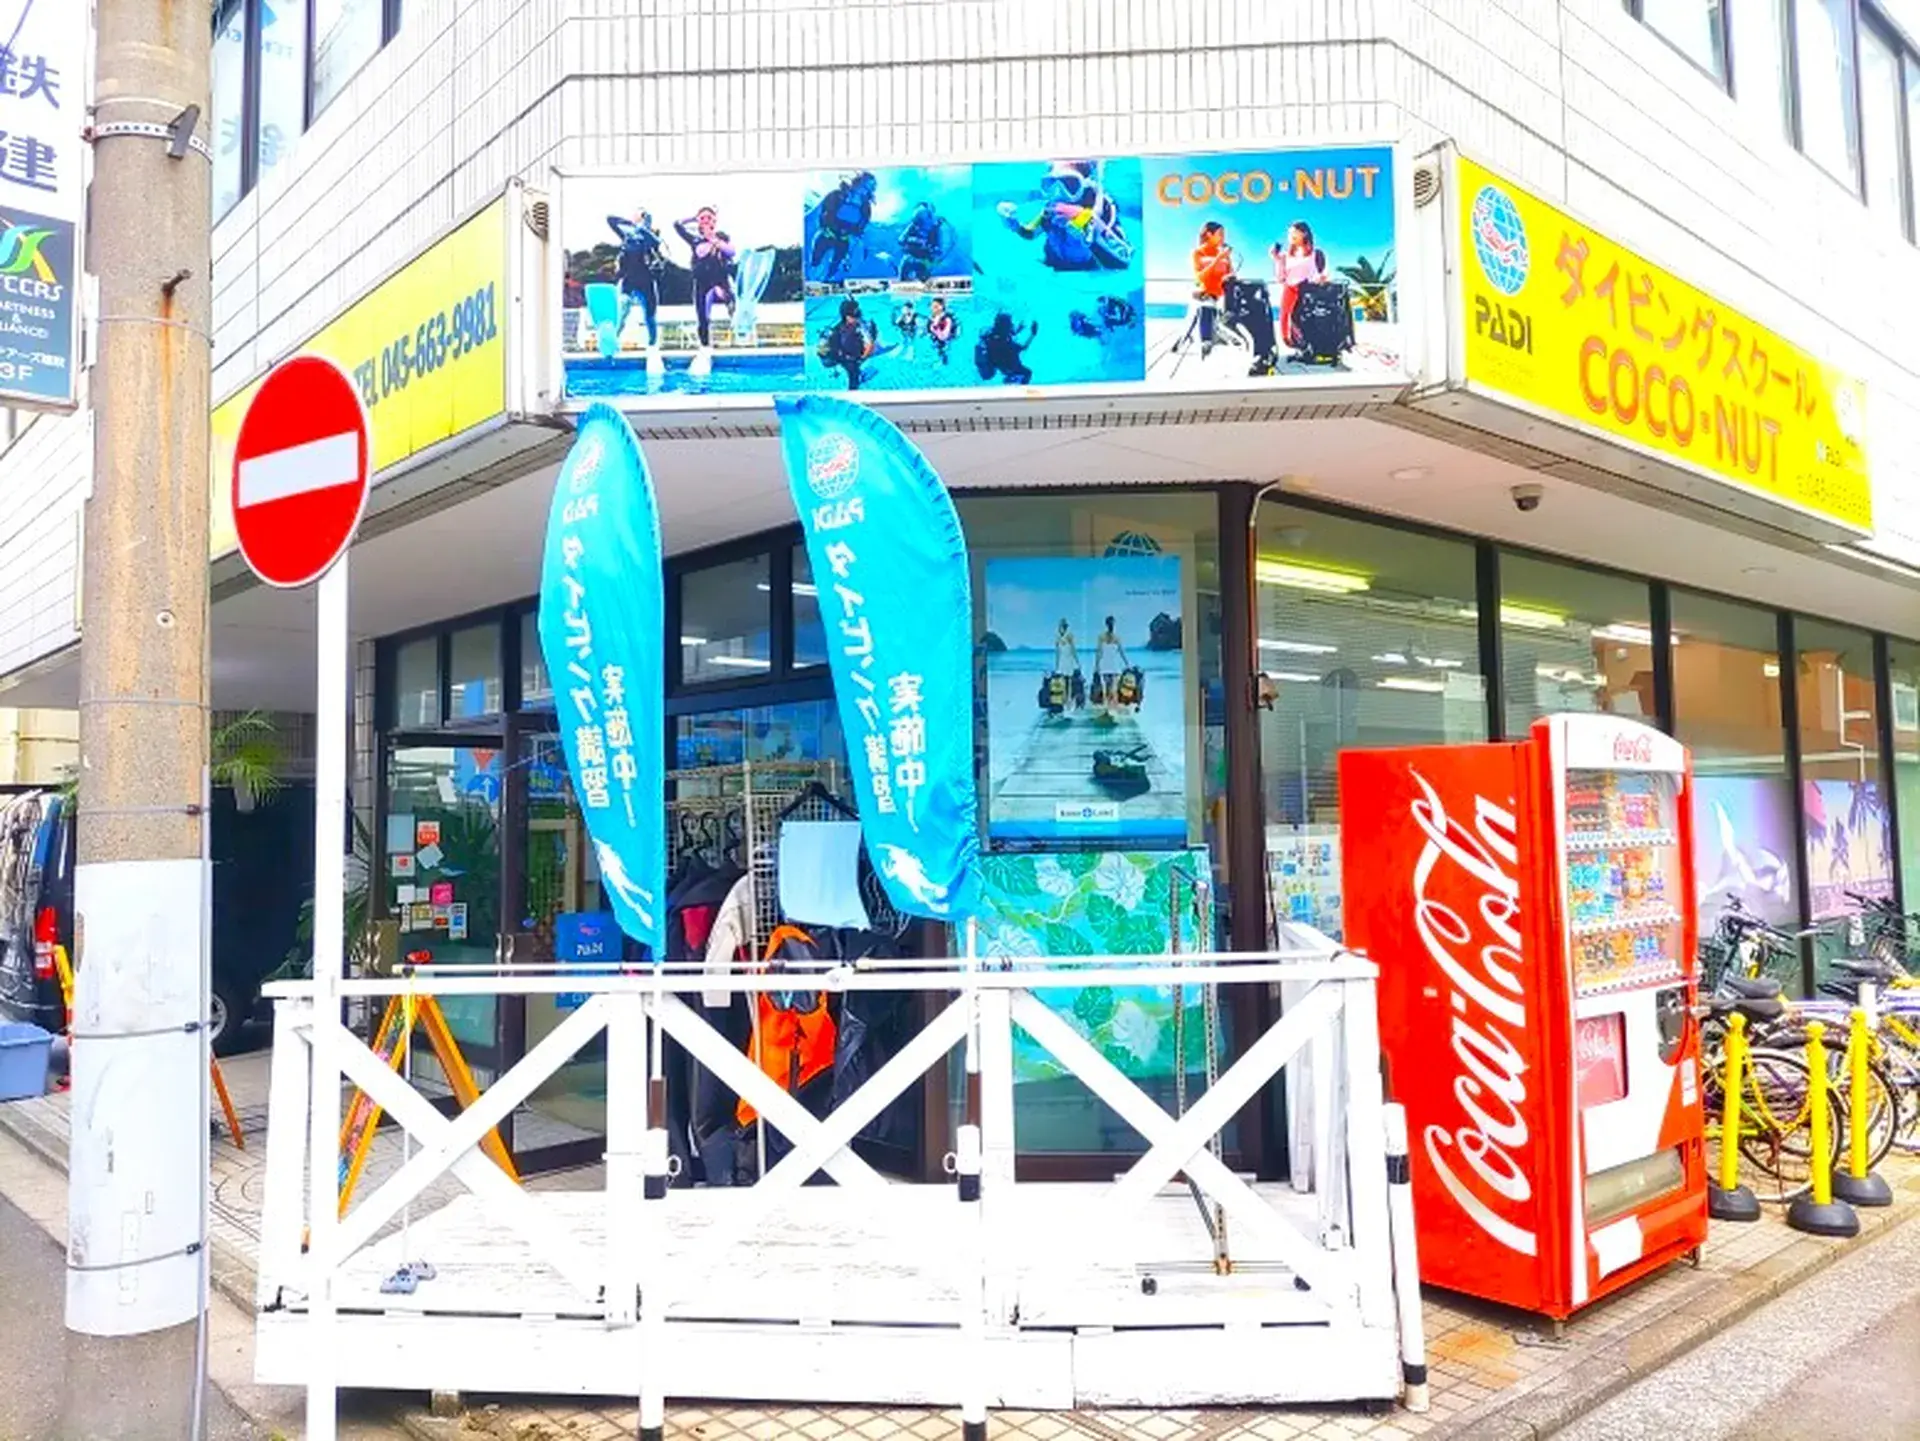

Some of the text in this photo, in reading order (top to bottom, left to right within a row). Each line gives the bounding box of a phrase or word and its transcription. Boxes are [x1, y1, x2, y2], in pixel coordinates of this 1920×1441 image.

[381, 280, 498, 399] 045-663-9981
[1474, 293, 1533, 356] PADI
[1553, 229, 1818, 420] ダイビングスクール
[1409, 762, 1538, 1258] Coca-Cola
